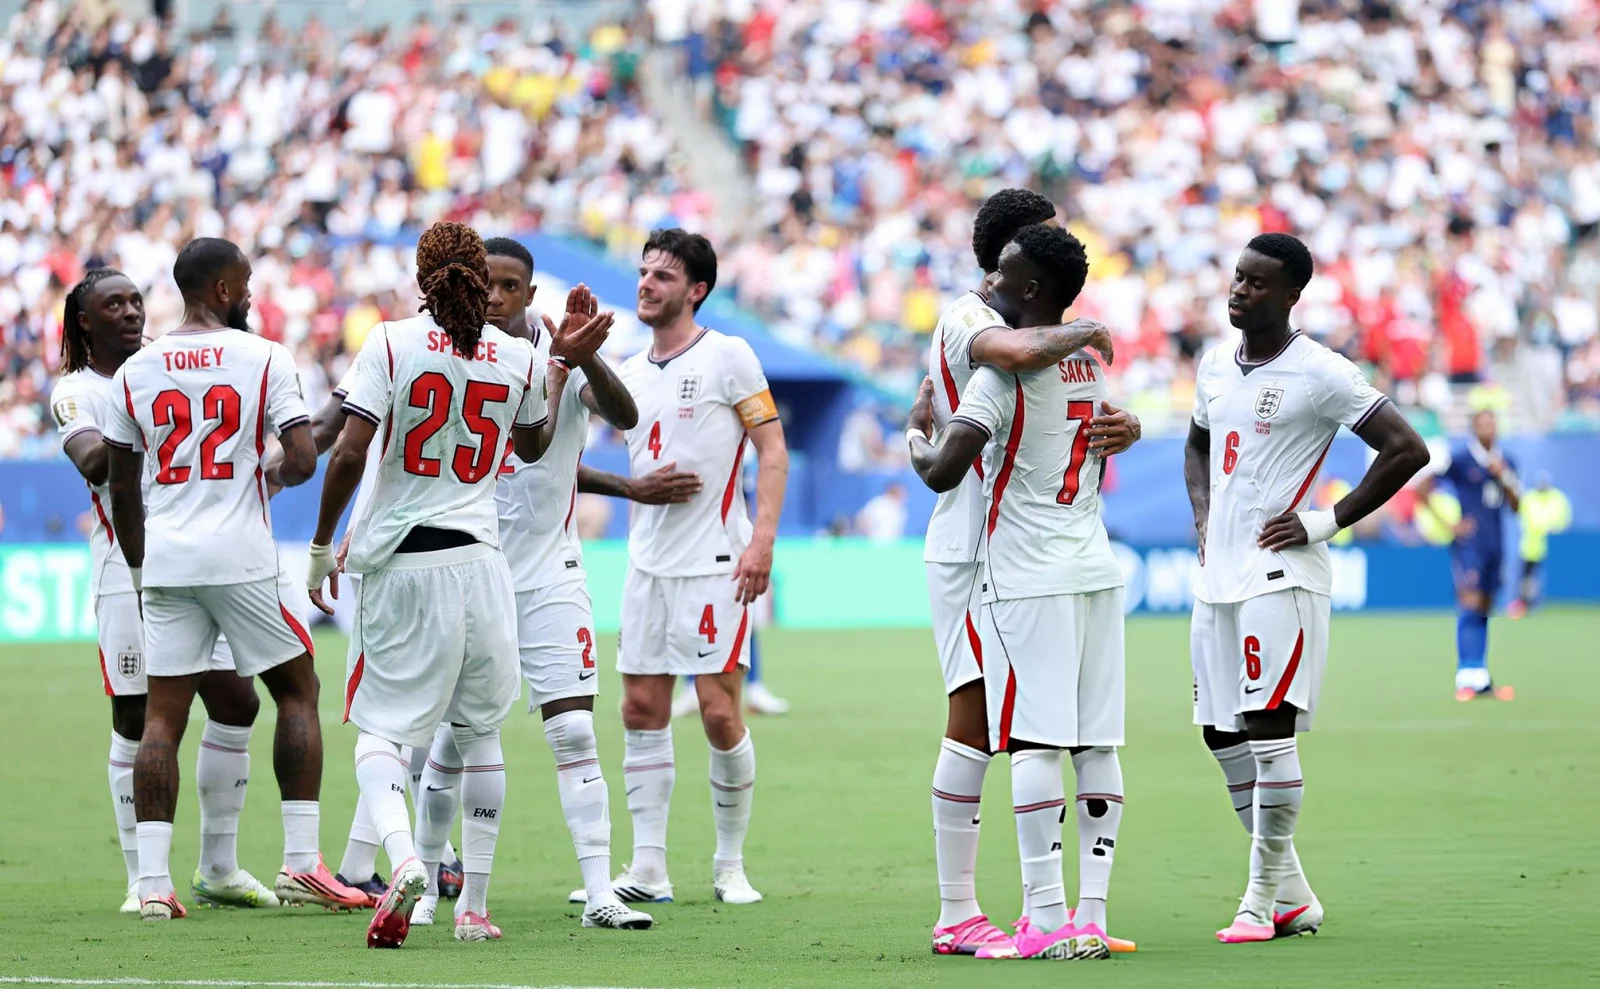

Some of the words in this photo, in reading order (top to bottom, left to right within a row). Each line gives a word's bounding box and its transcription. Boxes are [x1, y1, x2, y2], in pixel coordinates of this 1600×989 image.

[163, 347, 224, 371] TONEY
[427, 330, 497, 363] SPCE
[1058, 359, 1096, 383] SAKA
[151, 384, 241, 484] 22
[403, 371, 510, 484] 25
[647, 420, 662, 460] 4
[1055, 400, 1093, 506] 7
[1223, 430, 1240, 475] 6
[698, 604, 718, 644] 4
[577, 627, 595, 668] 2
[1244, 635, 1262, 681] 6
[120, 795, 134, 804] EN
[473, 807, 497, 819] ENG
